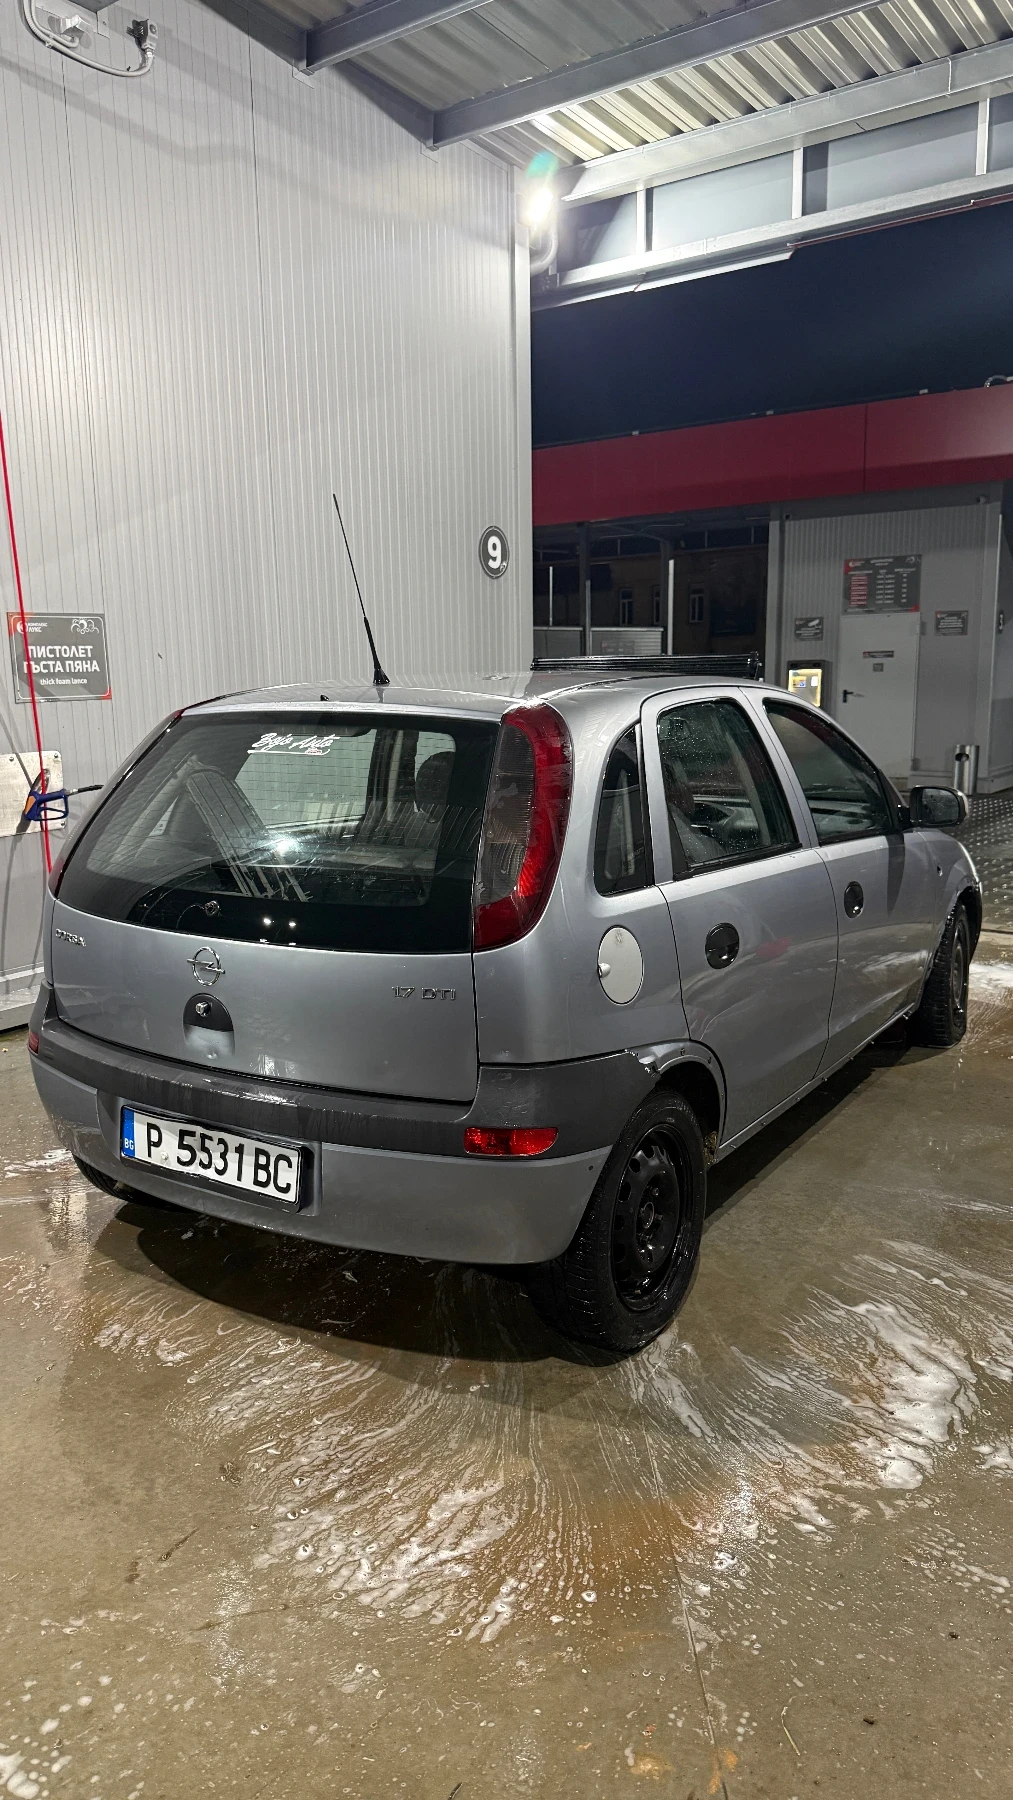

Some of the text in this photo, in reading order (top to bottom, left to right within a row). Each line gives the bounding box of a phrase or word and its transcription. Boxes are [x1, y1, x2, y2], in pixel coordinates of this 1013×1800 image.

[487, 535, 502, 569] 9
[28, 646, 93, 658] ПИСТОЛЕТ
[65, 660, 100, 673] ПЯНА
[288, 733, 341, 750] Auto
[55, 928, 87, 947] CORSA
[421, 987, 456, 1001] DTI
[124, 1137, 135, 1151] BG
[146, 1122, 163, 1158] P
